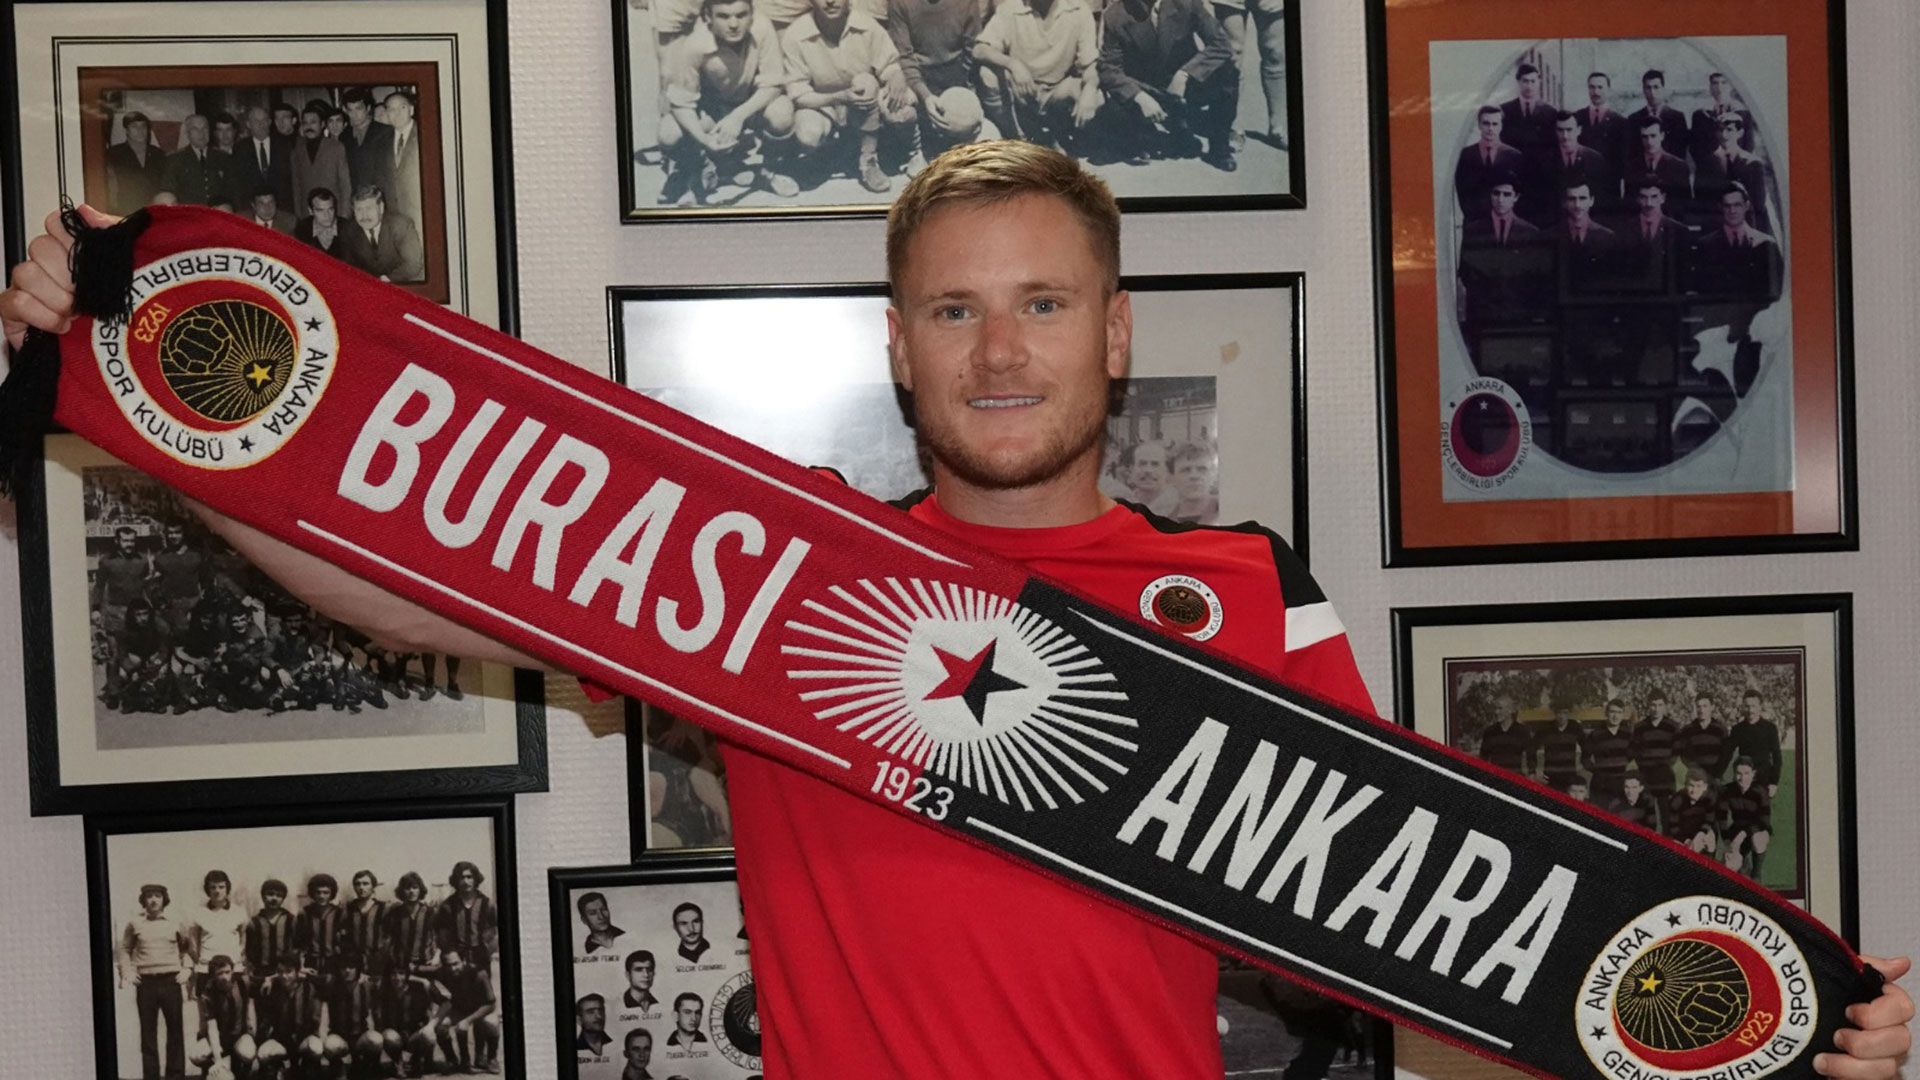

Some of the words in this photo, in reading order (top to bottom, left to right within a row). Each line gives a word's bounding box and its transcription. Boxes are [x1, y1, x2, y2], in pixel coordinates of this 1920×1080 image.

[129, 254, 309, 306] GENÇLERBİRLİ
[134, 303, 171, 343] 1923
[100, 322, 135, 397] SPOR
[132, 401, 225, 462] KULÜBÜ
[262, 347, 329, 436] ANKARA
[1465, 380, 1504, 393] ANKARA
[337, 362, 812, 676] BURASI
[1165, 577, 1202, 590] ANKARA
[871, 760, 955, 821] 1923
[1115, 716, 1579, 1006] ANKARA
[1697, 903, 1787, 957] KULÜBÜ
[1585, 927, 1654, 1011] ANKARA
[1781, 959, 1810, 1027] SPOR
[1735, 1010, 1774, 1047] 1923
